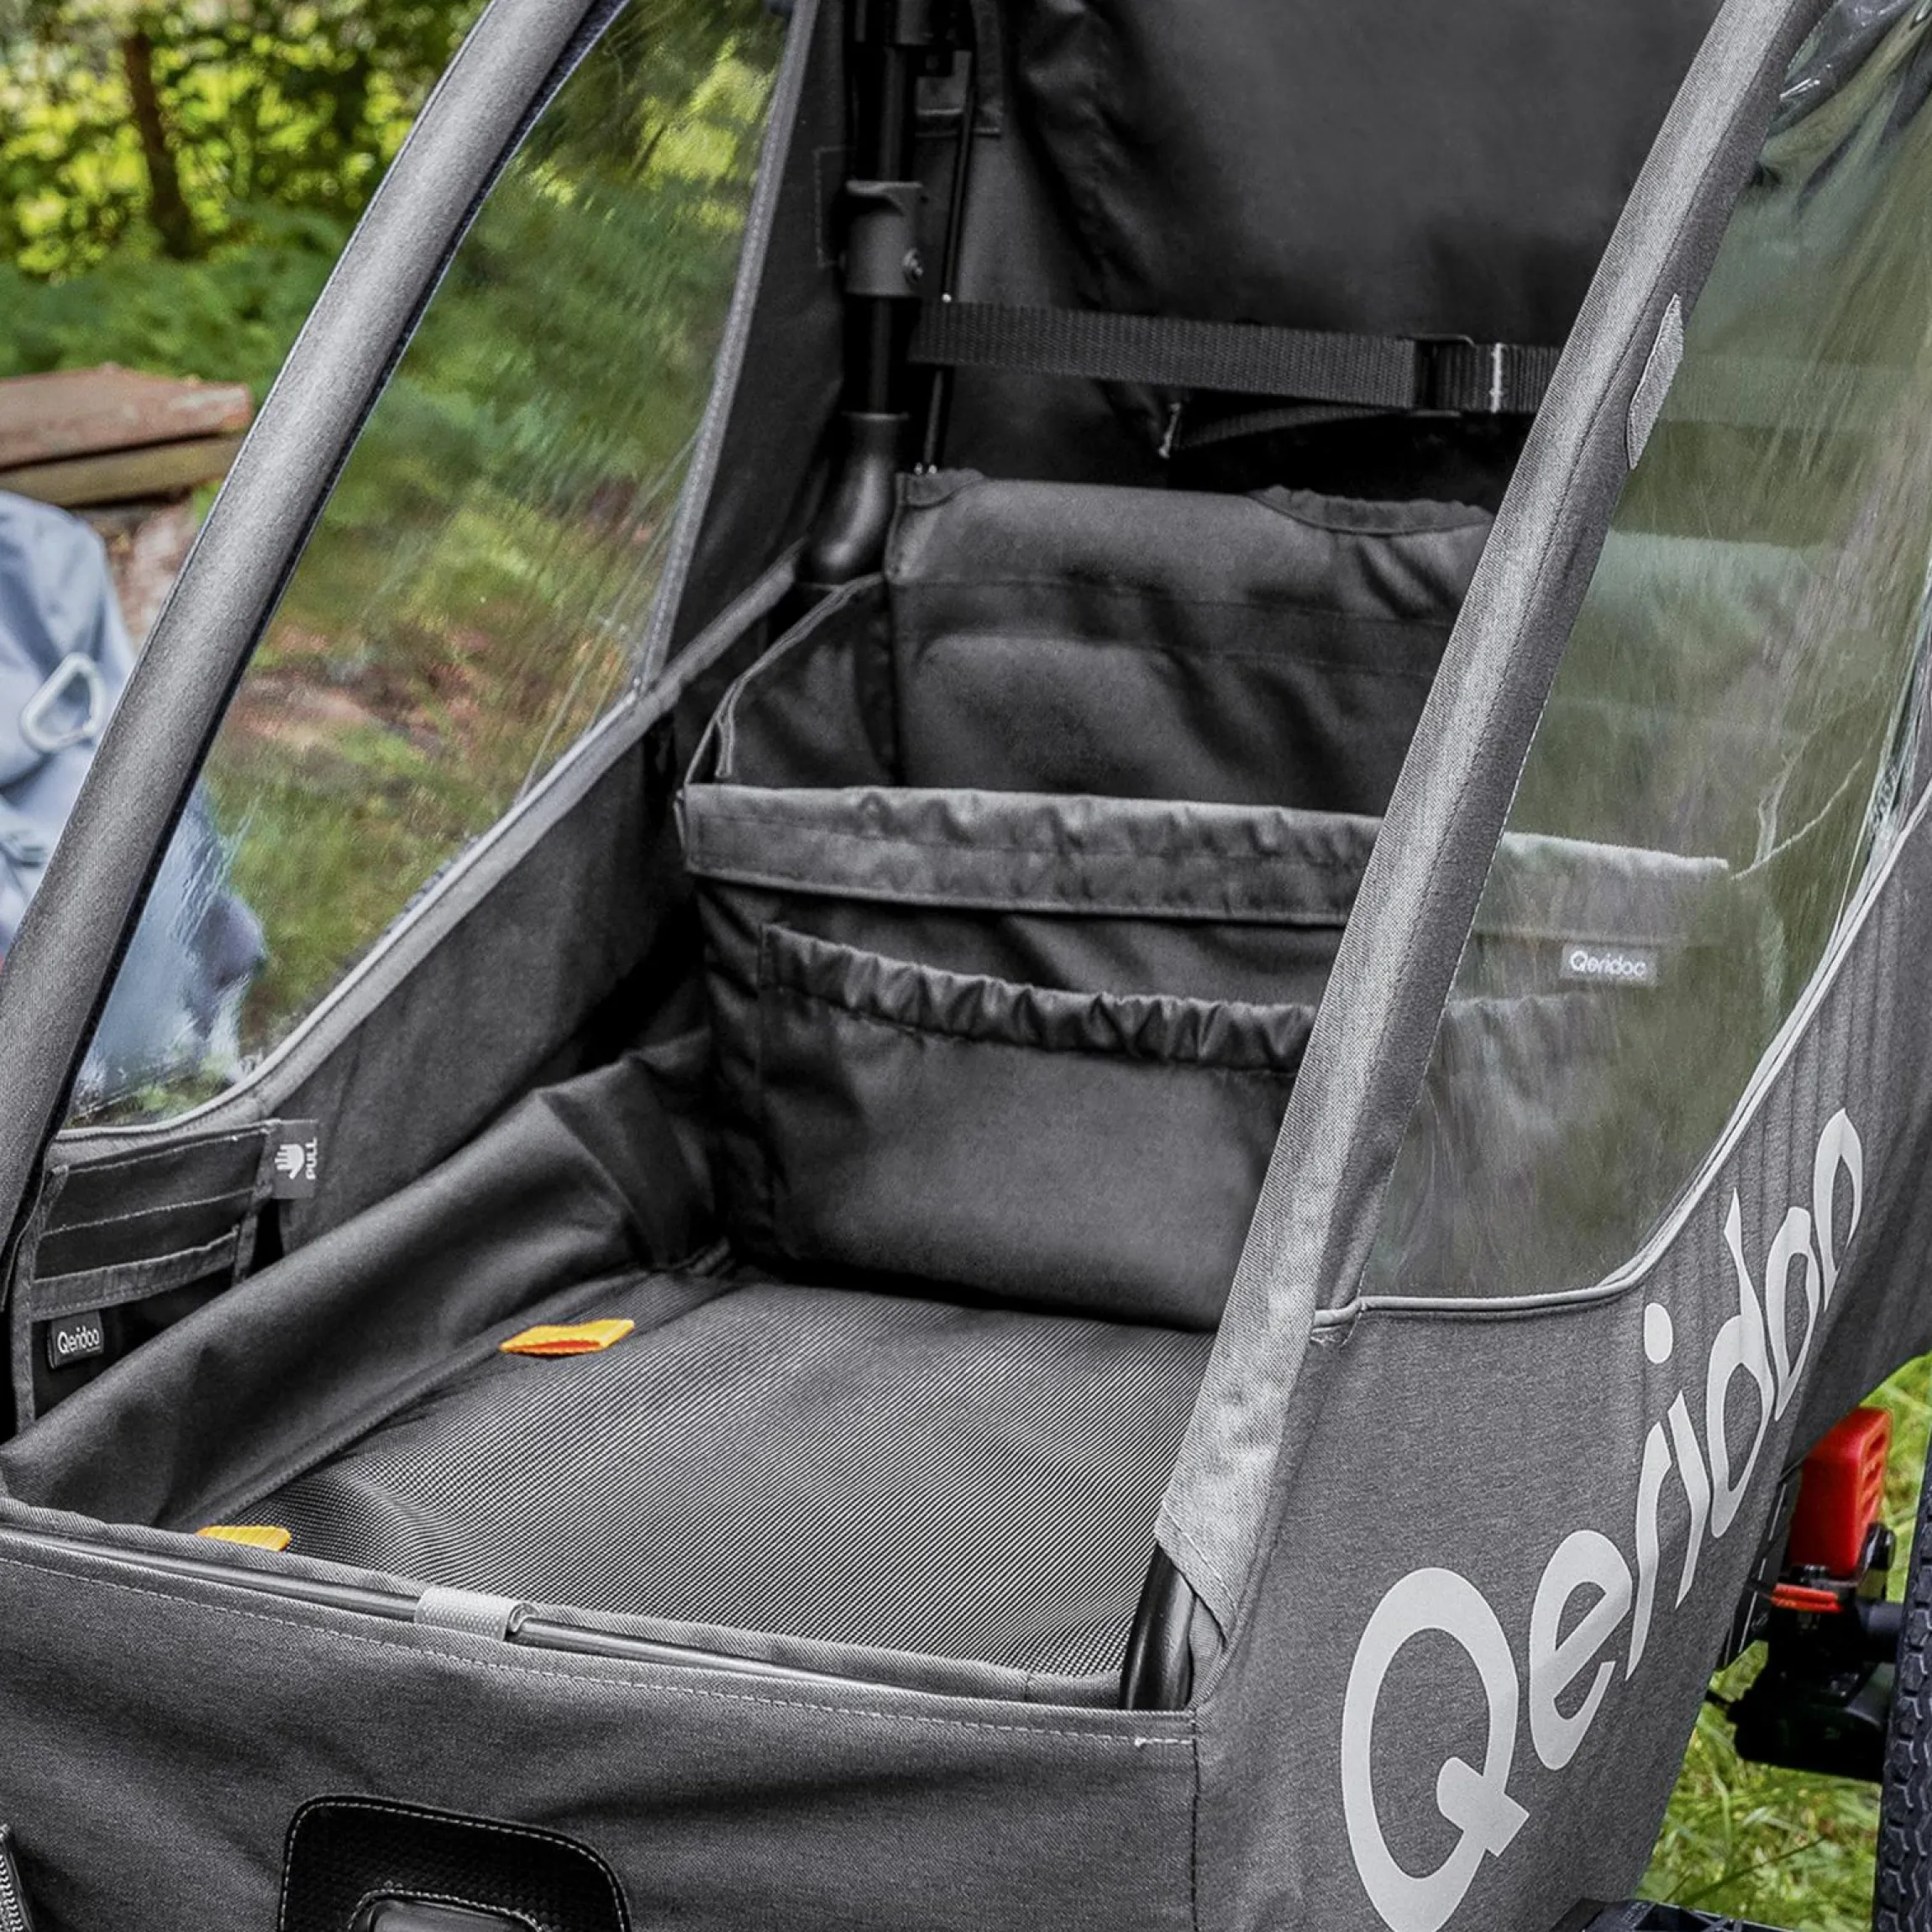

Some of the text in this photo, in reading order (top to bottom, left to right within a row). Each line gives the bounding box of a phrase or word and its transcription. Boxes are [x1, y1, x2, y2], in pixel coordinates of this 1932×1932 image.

[305, 1137, 318, 1179] PULL
[57, 1326, 100, 1354] Qeridoo
[1341, 1108, 1862, 1932] Qeridoo
